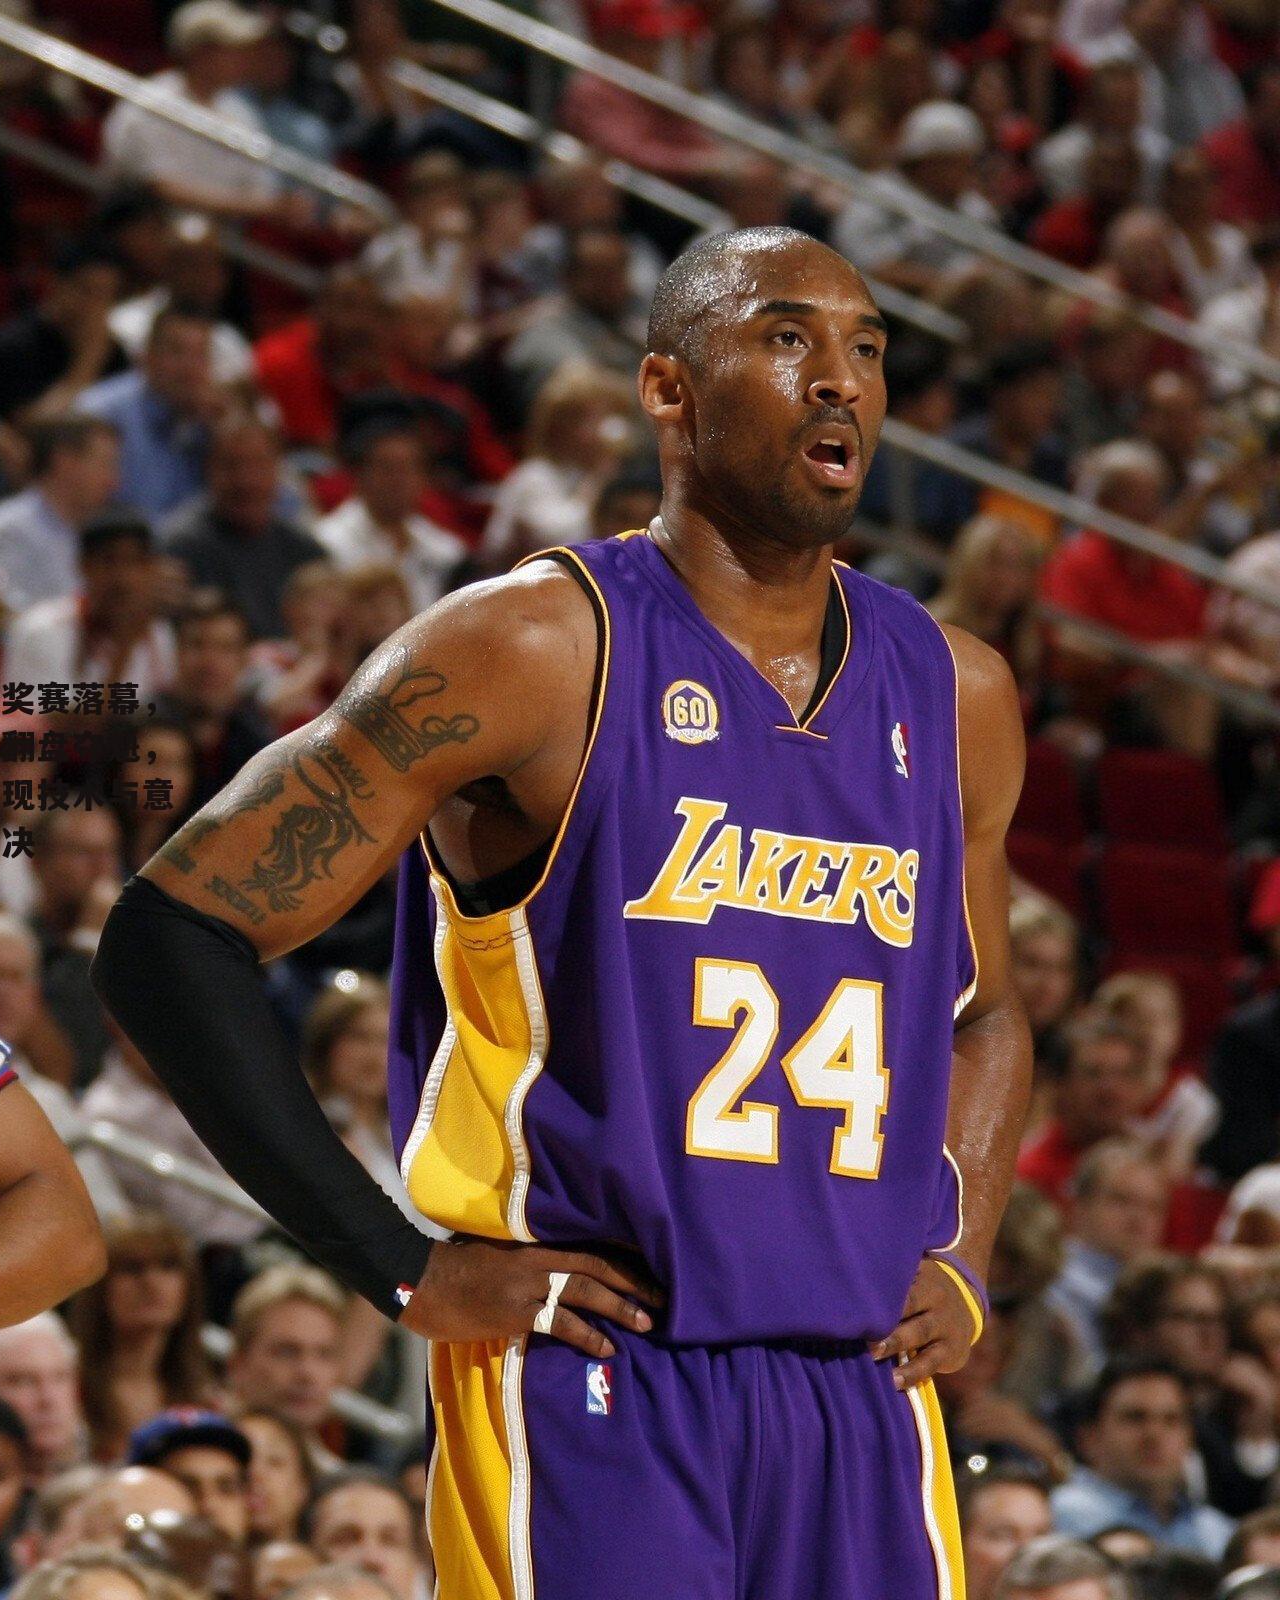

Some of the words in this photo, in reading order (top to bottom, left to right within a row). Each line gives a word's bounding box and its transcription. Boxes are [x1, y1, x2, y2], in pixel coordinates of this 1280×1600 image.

[673, 696, 706, 727] 60
[623, 796, 919, 948] LAKERS
[686, 957, 890, 1180] 24
